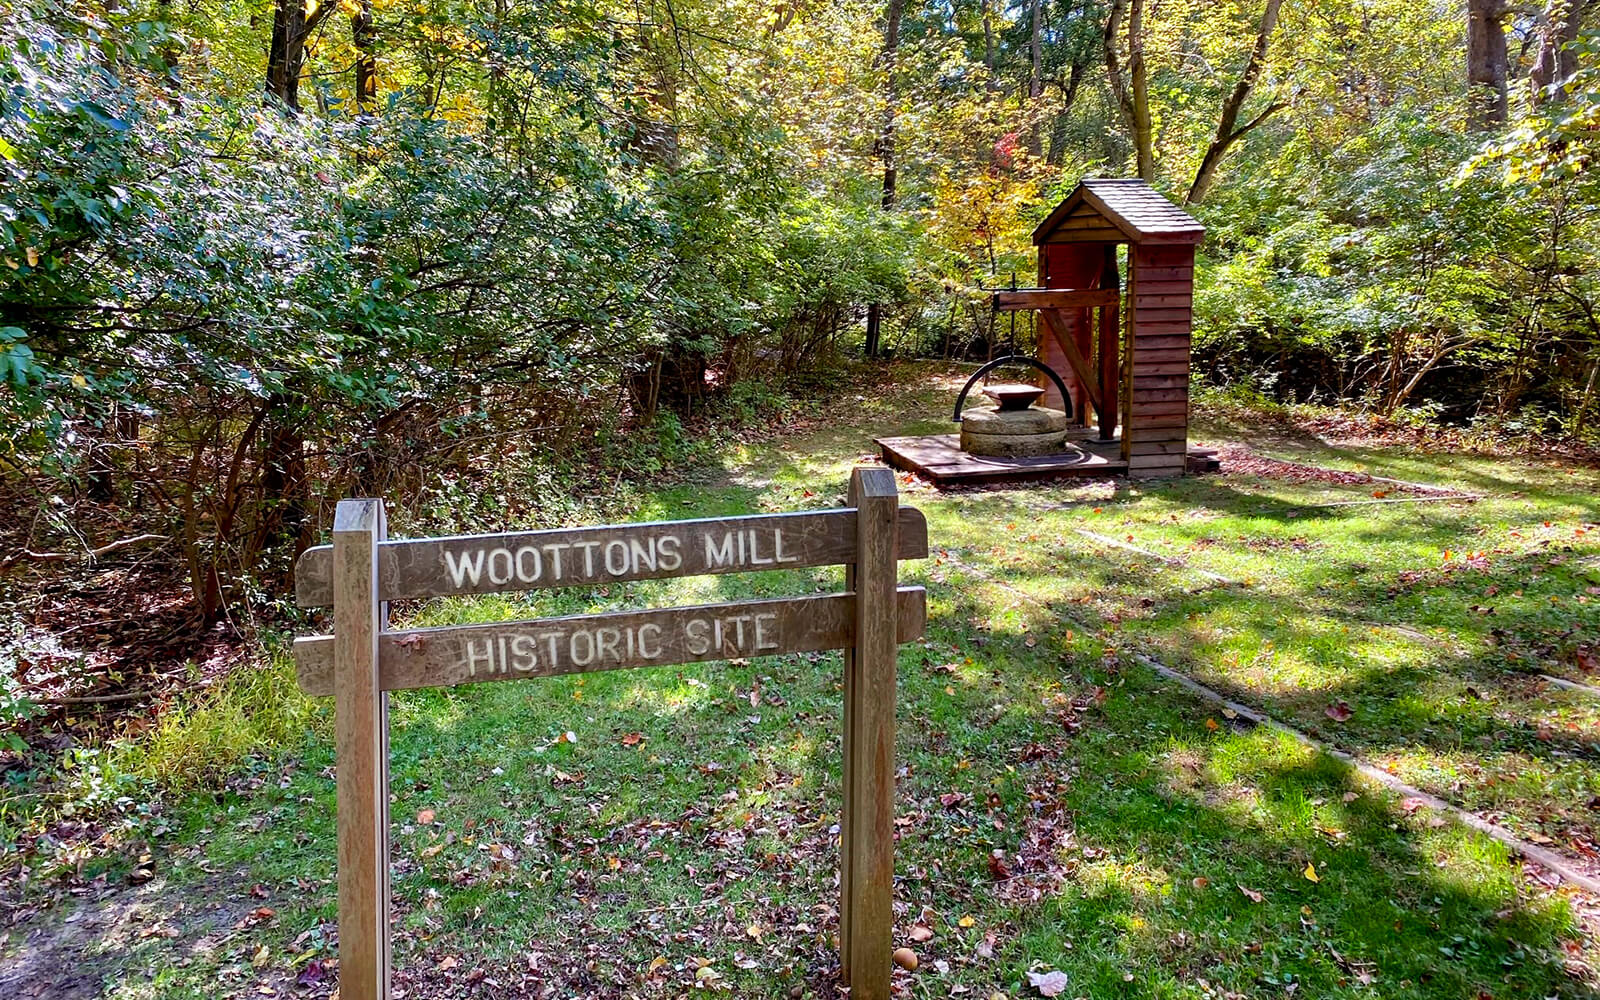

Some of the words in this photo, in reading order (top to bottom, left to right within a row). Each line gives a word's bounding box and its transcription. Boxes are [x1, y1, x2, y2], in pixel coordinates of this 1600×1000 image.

[445, 535, 682, 588] WOOTTONS
[706, 528, 798, 568] MILL
[467, 623, 663, 676] HISTORIC
[686, 613, 778, 656] SITE
